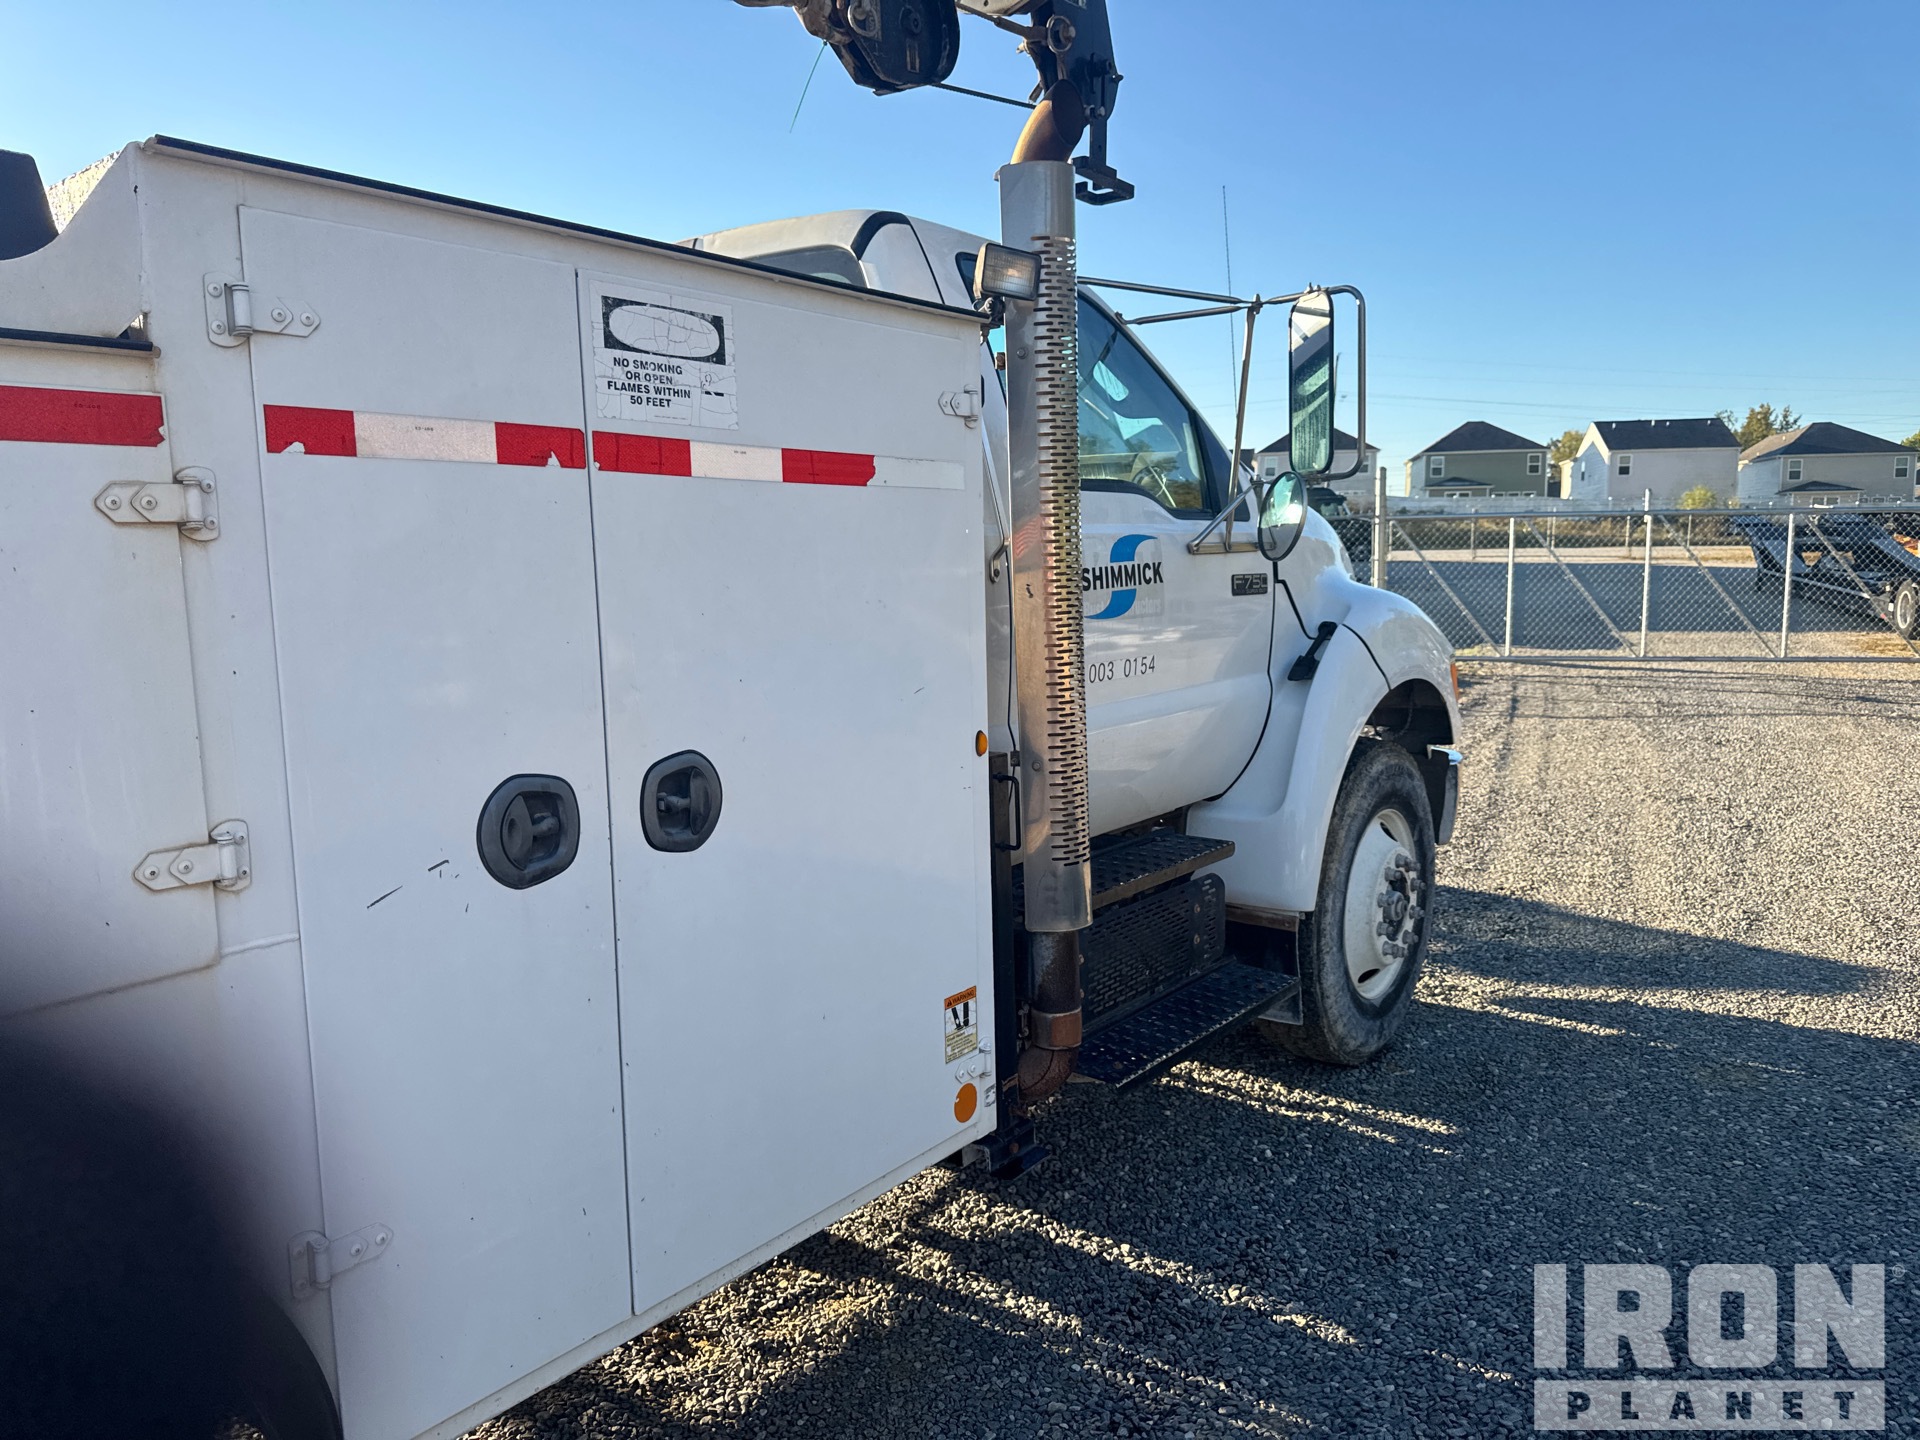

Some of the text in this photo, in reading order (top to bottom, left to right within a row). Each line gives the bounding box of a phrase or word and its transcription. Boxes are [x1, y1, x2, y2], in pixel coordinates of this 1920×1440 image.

[613, 356, 683, 375] NO SMOKING
[625, 370, 673, 385] OR OPEN
[607, 380, 691, 399] FLAMES WITHIN
[630, 395, 672, 408] 50 FEET
[1082, 561, 1164, 591] SHIMMICK
[1089, 654, 1155, 683] 003 0154
[952, 989, 975, 1004] WARNING
